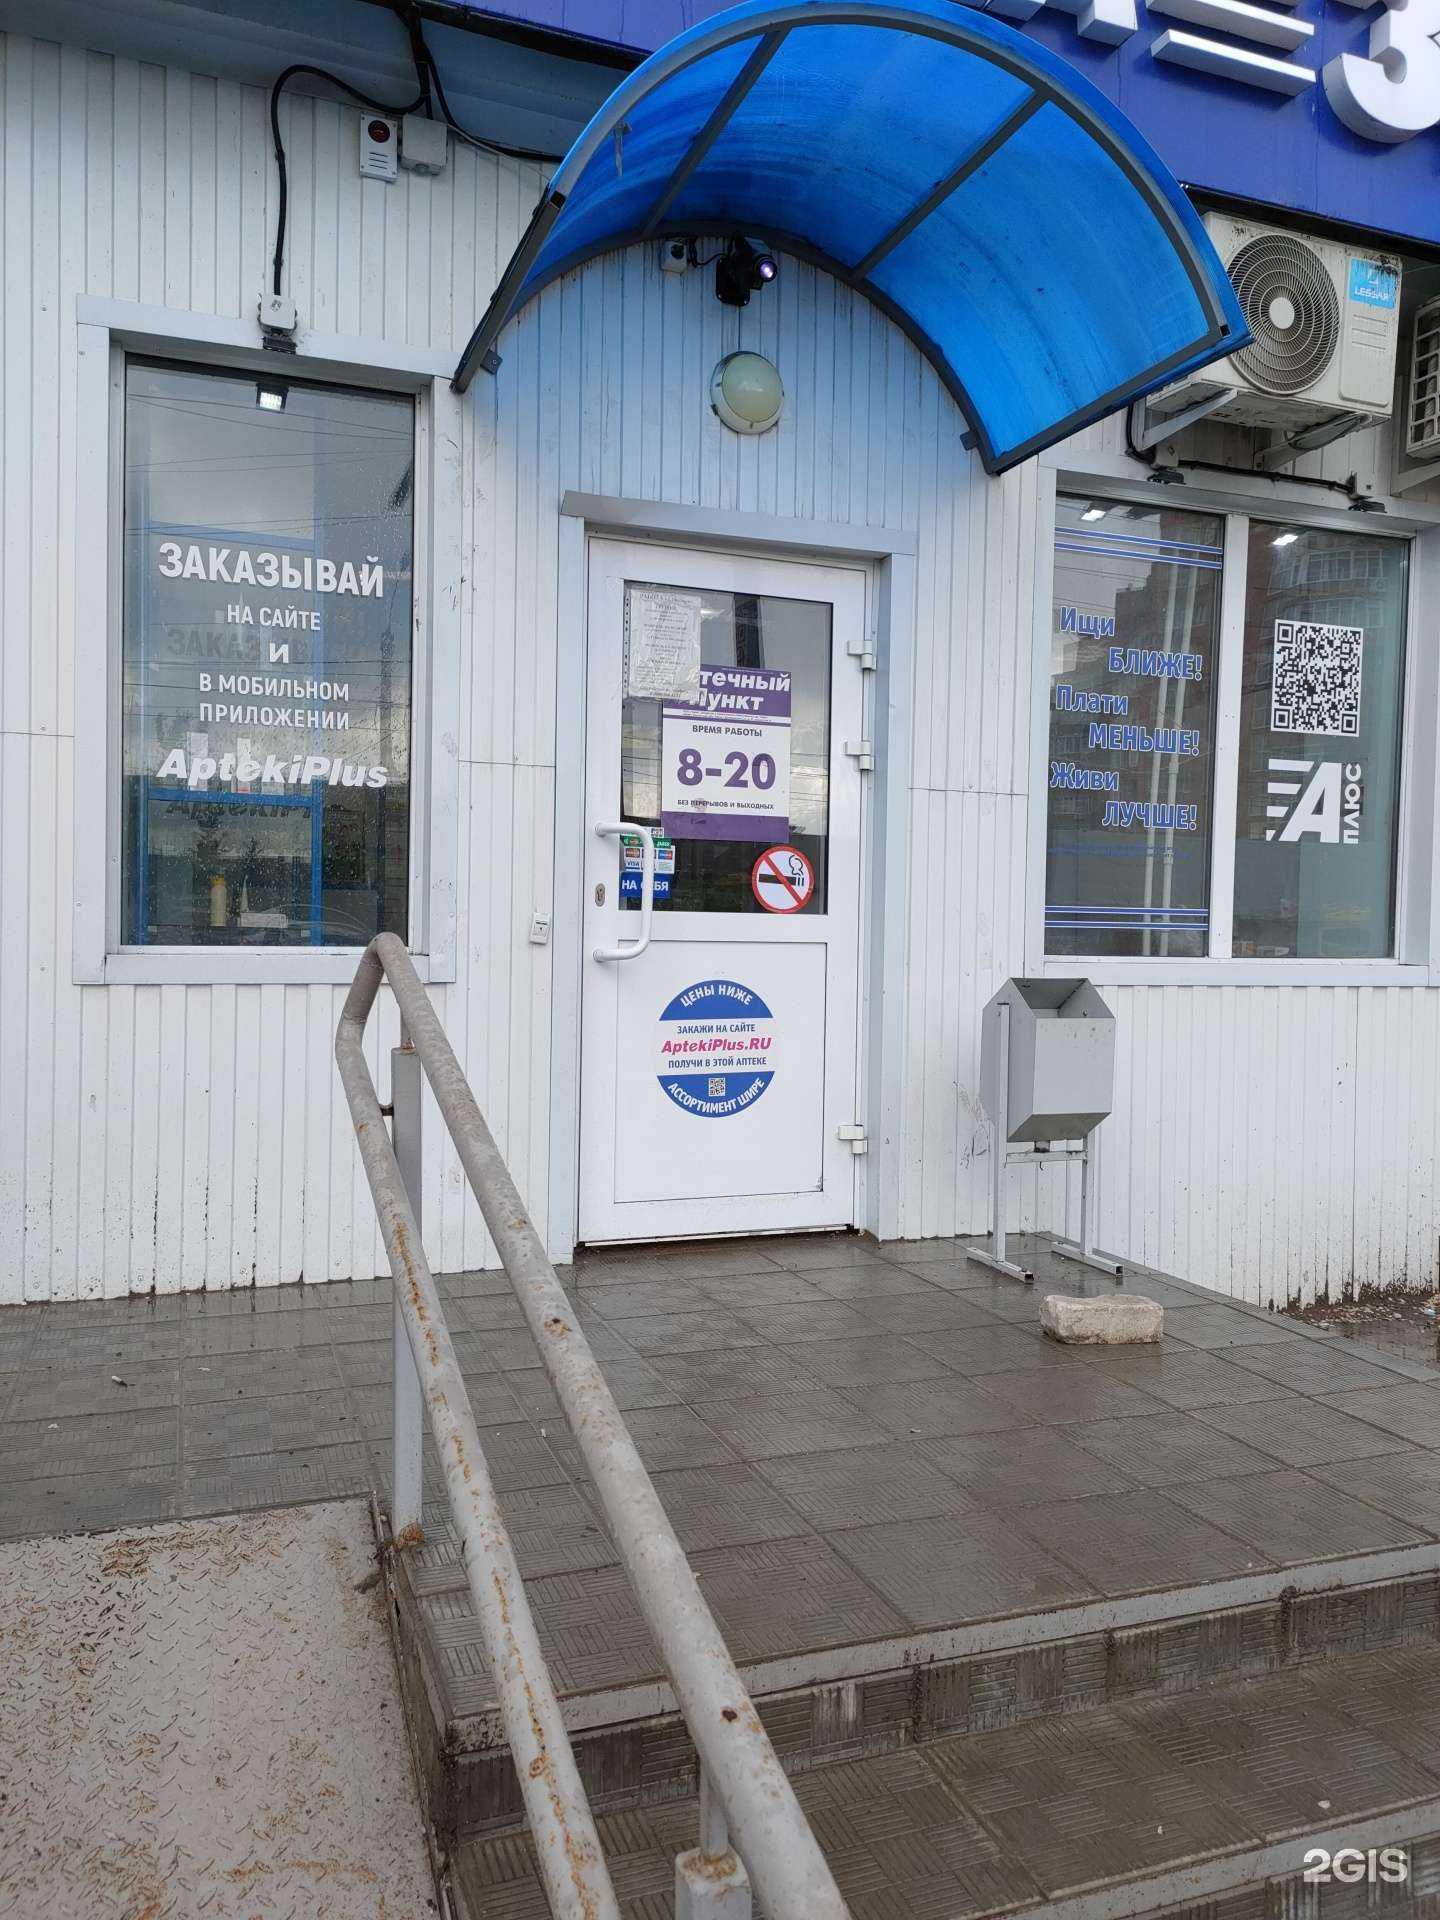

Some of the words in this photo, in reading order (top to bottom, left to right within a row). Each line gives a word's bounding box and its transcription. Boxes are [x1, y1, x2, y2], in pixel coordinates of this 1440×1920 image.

[158, 542, 384, 598] ЗАКАЗЫВАЙ
[227, 604, 254, 626] НА
[259, 604, 321, 631] САЙТЕ
[1059, 606, 1115, 640] Ищи
[269, 642, 289, 664] И
[1108, 646, 1203, 681] БЛИЖЕ!
[199, 672, 212, 692] В
[219, 674, 349, 701] МОБИЛЬНОМ
[1055, 684, 1128, 716] Плати
[199, 703, 349, 730] ПРИЛОЖЕНИИ
[692, 724, 722, 735] ВРЕМЯ
[725, 727, 762, 737] РАБОТЫ
[1089, 723, 1201, 756] МЕНЬШЕ!
[156, 749, 388, 788] AptekiPlus
[677, 748, 777, 790] 8-20
[1049, 761, 1119, 792] Живи
[691, 800, 729, 808] ПЕРЕРЫВОВ
[737, 801, 774, 810] ВЫХОДНЫХ
[1101, 799, 1198, 831] ЛУЧШЕ!
[1343, 763, 1362, 844] ПЛЮС
[621, 880, 638, 890] НА
[680, 985, 714, 1007] ЦЕНЫ
[718, 985, 753, 1006] НИЖЕ
[677, 1025, 714, 1034] ЗАКАЖИ
[716, 1024, 728, 1033] НА
[729, 1022, 756, 1033] САЙТЕ
[661, 1037, 772, 1055] AptekiPlus.RU
[668, 1058, 703, 1069] ПОЛУЧИ
[705, 1059, 711, 1067] В
[713, 1056, 734, 1067] ЭТОЙ
[736, 1057, 767, 1066] АПТЕКЕ
[667, 1082, 738, 1114] АССОРТИМЕНТ
[738, 1077, 765, 1105] ШИРЕ
